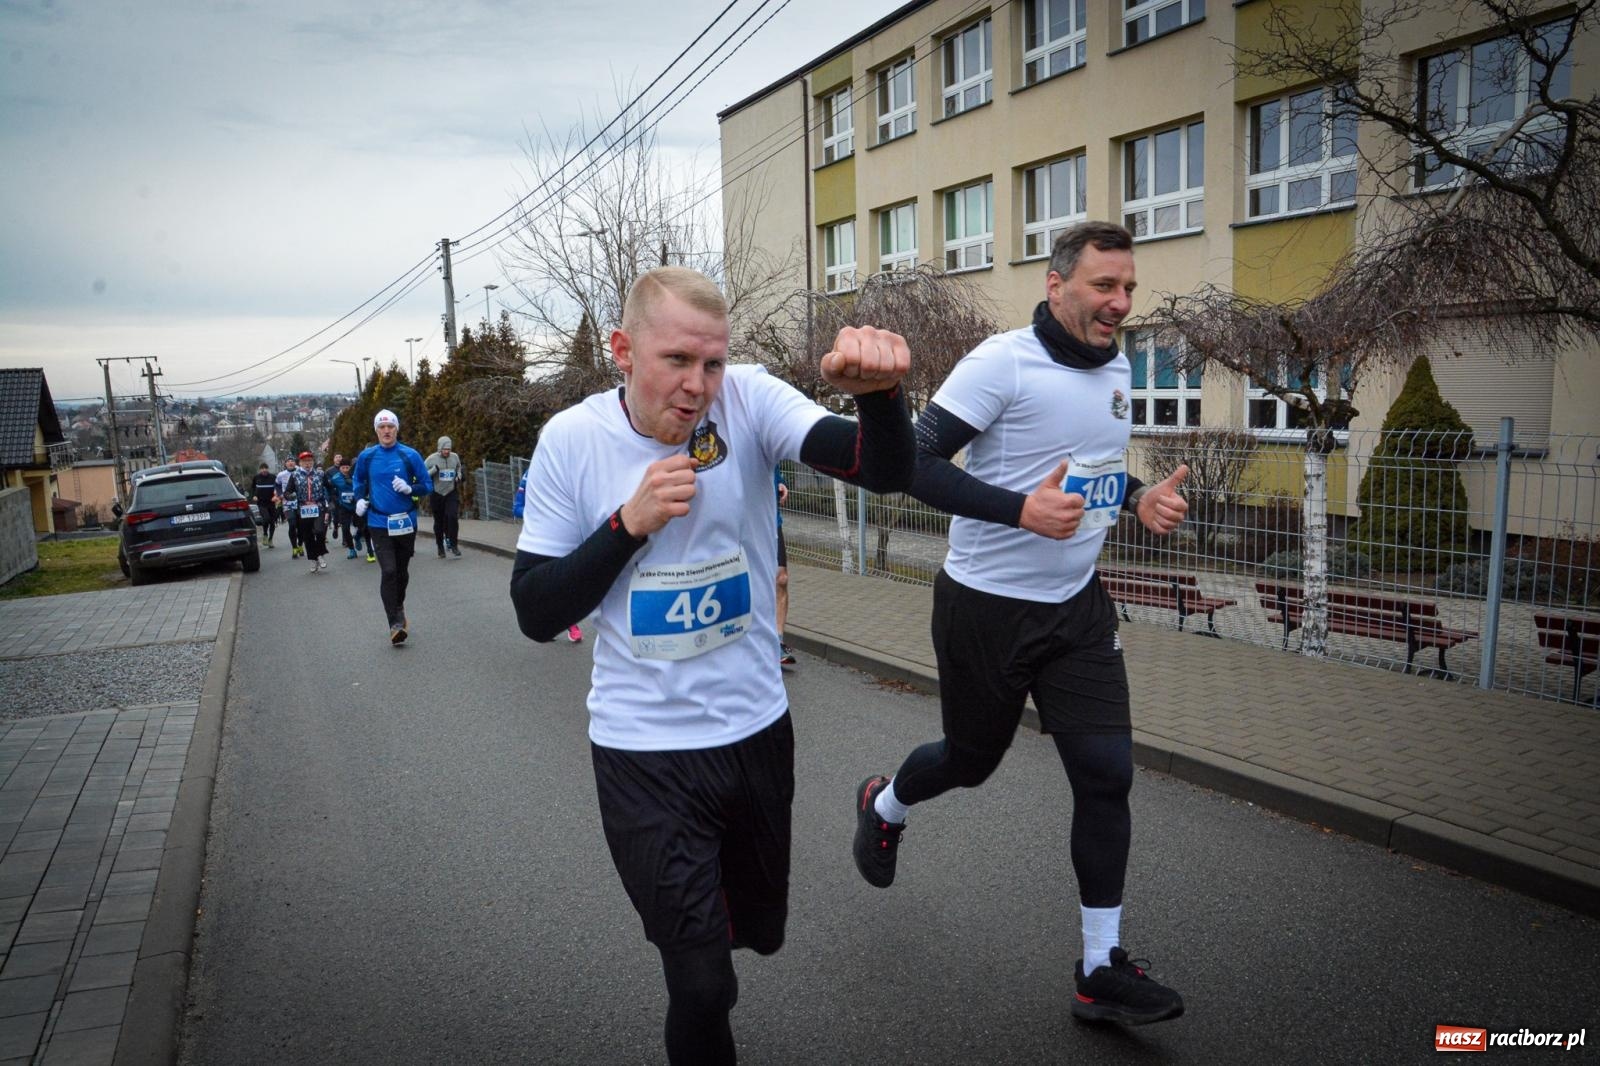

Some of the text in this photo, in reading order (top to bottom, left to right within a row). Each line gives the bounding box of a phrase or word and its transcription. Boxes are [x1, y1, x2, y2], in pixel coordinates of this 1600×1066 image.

[1082, 475, 1118, 508] 140
[398, 519, 405, 529] 9
[686, 568, 705, 576] Ziemi
[665, 585, 722, 630] 46
